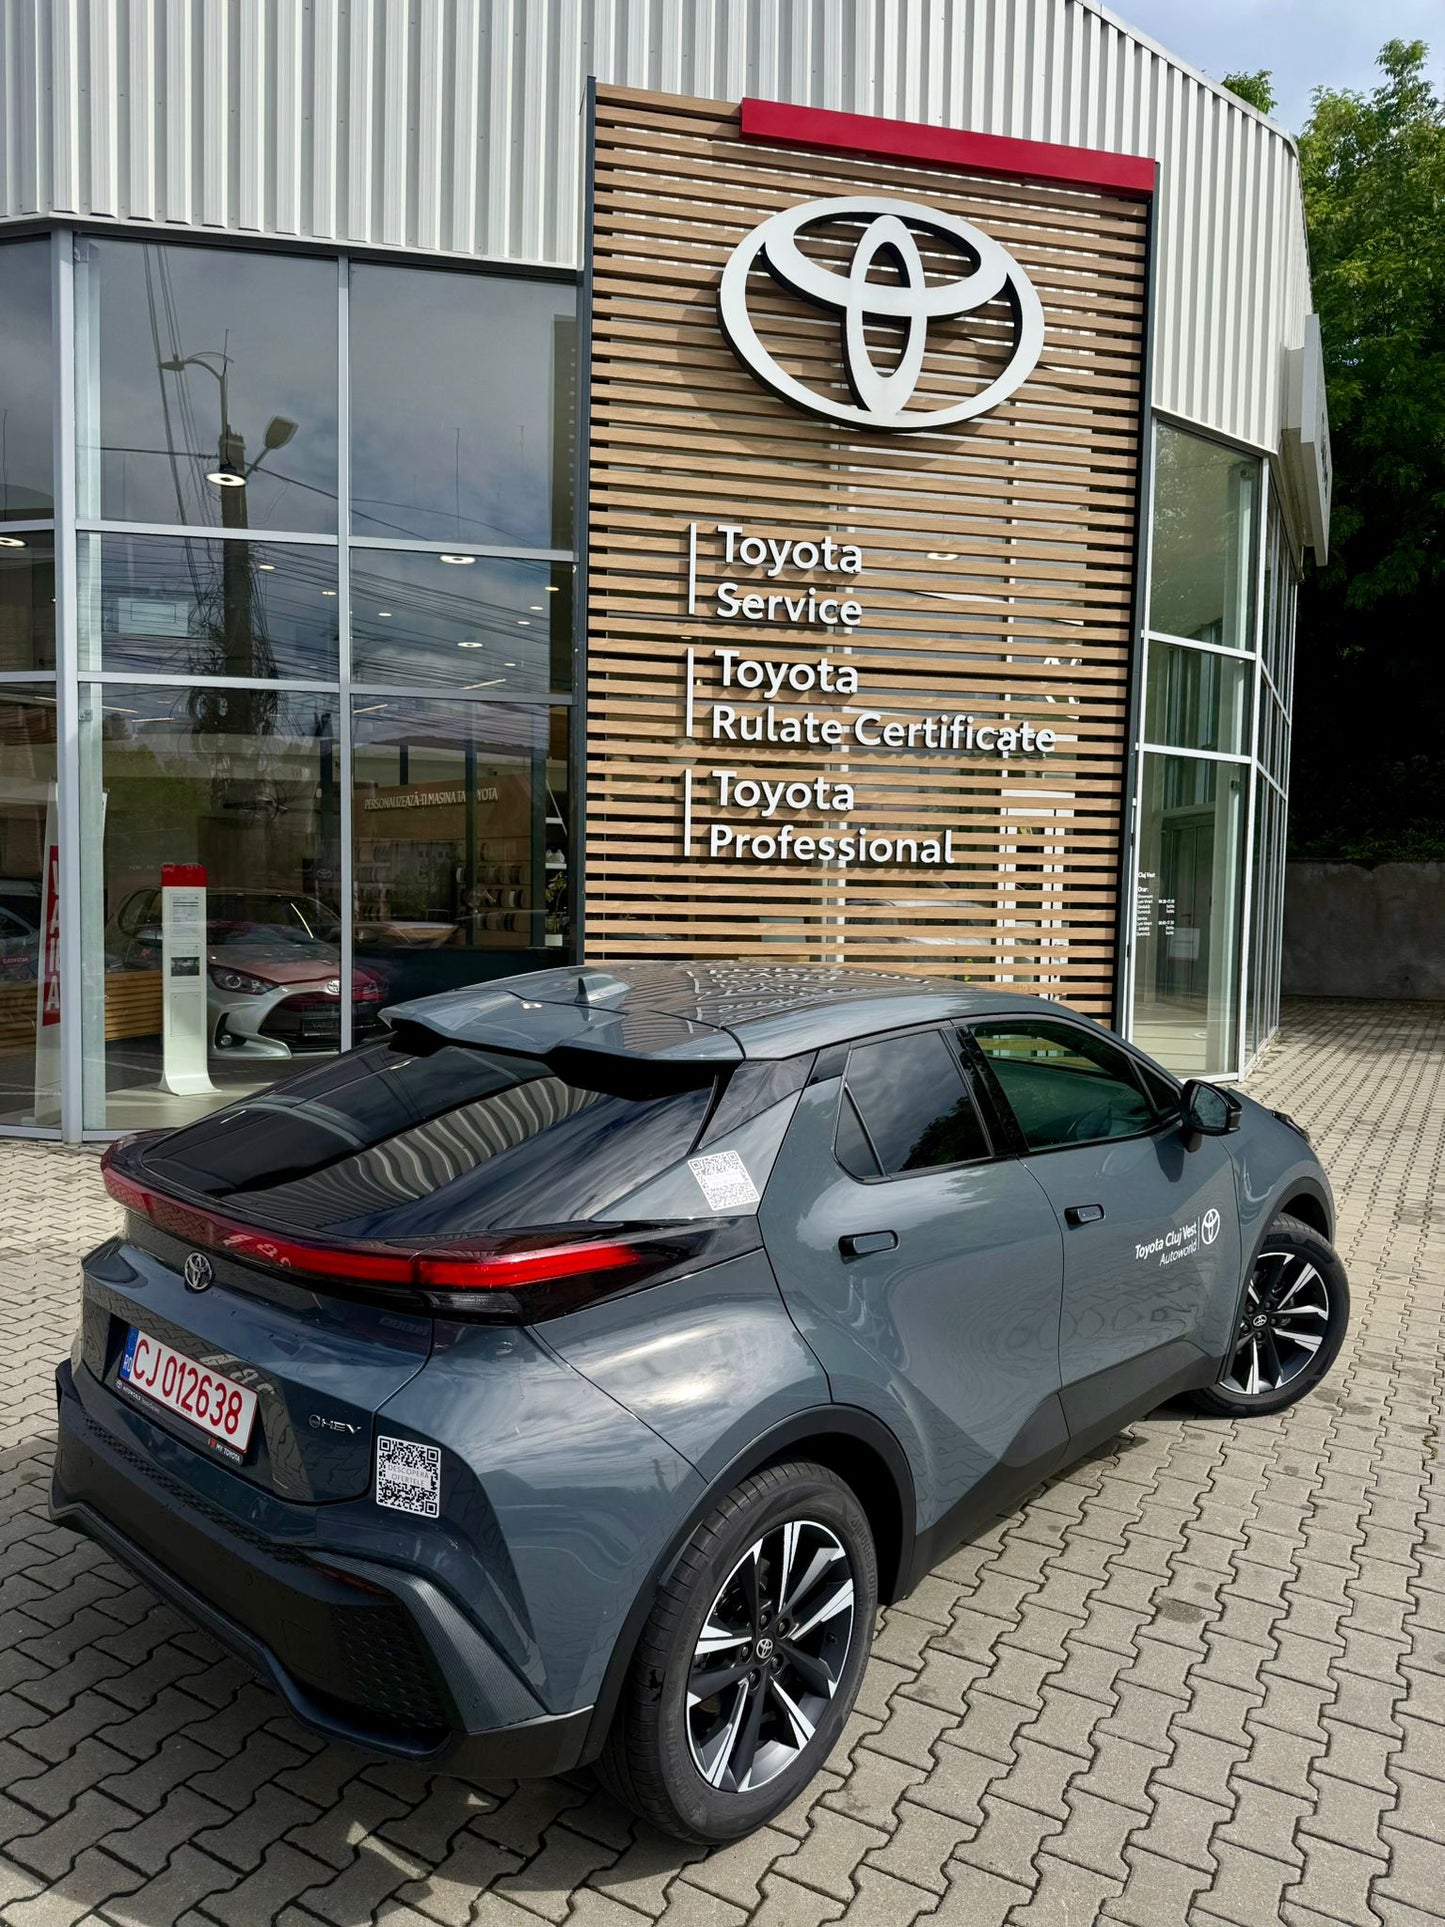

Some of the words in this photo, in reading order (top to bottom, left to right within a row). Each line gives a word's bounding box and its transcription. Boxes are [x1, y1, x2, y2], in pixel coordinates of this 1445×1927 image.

[716, 525, 863, 577] Toyota
[716, 582, 863, 627] Service
[715, 649, 859, 700] Toyota
[712, 705, 843, 745] Rulate
[854, 712, 1058, 753] Certificate
[711, 770, 856, 817] Toyota
[710, 824, 955, 864] Professional
[1135, 1238, 1164, 1260] Toyota
[1165, 1228, 1182, 1247] Cluj
[1182, 1221, 1197, 1240] Vest
[1159, 1238, 1197, 1267] Autoworld
